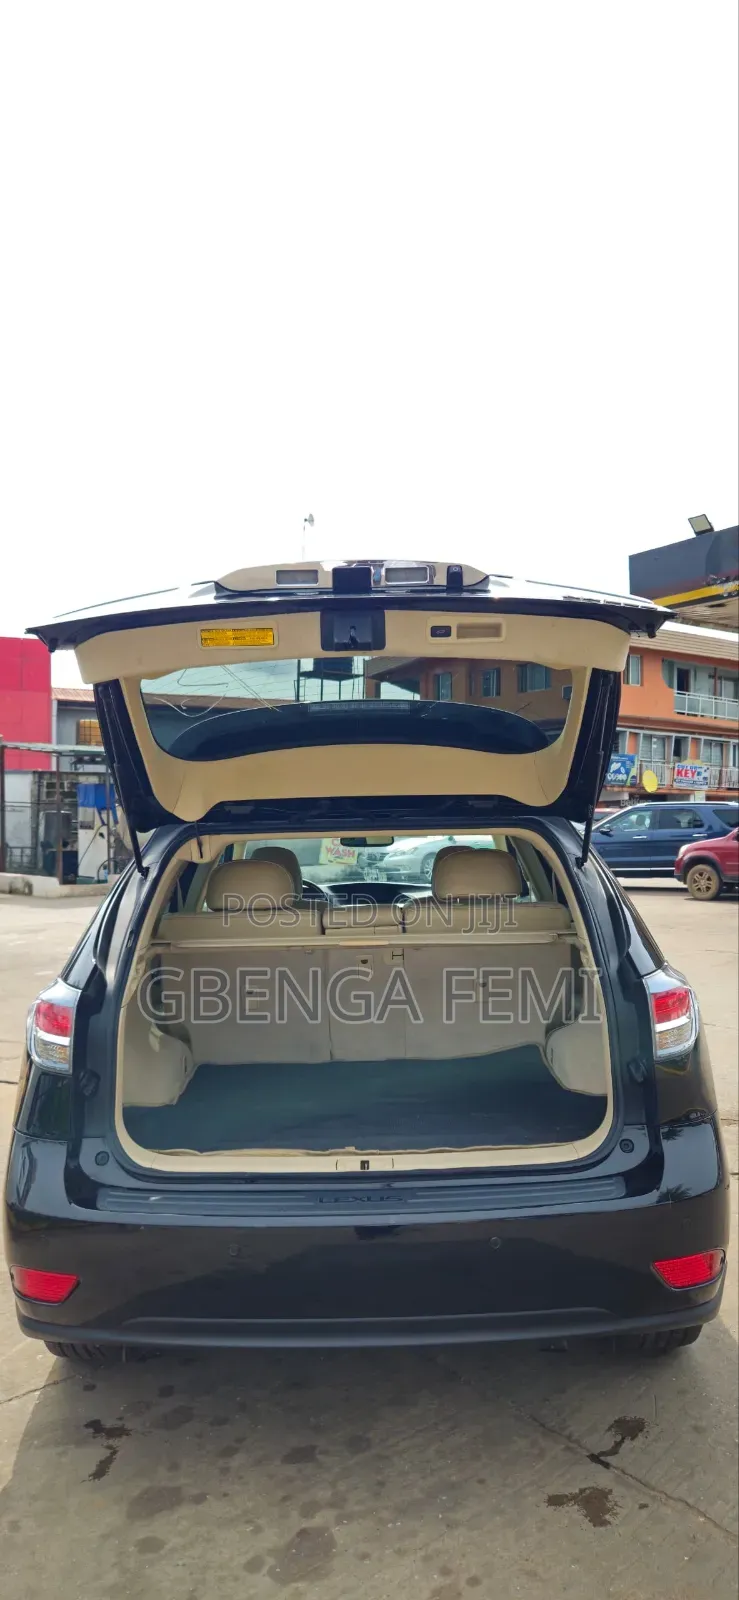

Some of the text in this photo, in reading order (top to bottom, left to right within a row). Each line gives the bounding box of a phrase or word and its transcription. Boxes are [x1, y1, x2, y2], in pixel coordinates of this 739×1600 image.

[676, 769, 697, 779] KEY
[326, 846, 356, 858] WASH
[318, 1195, 404, 1204] LEXUS
